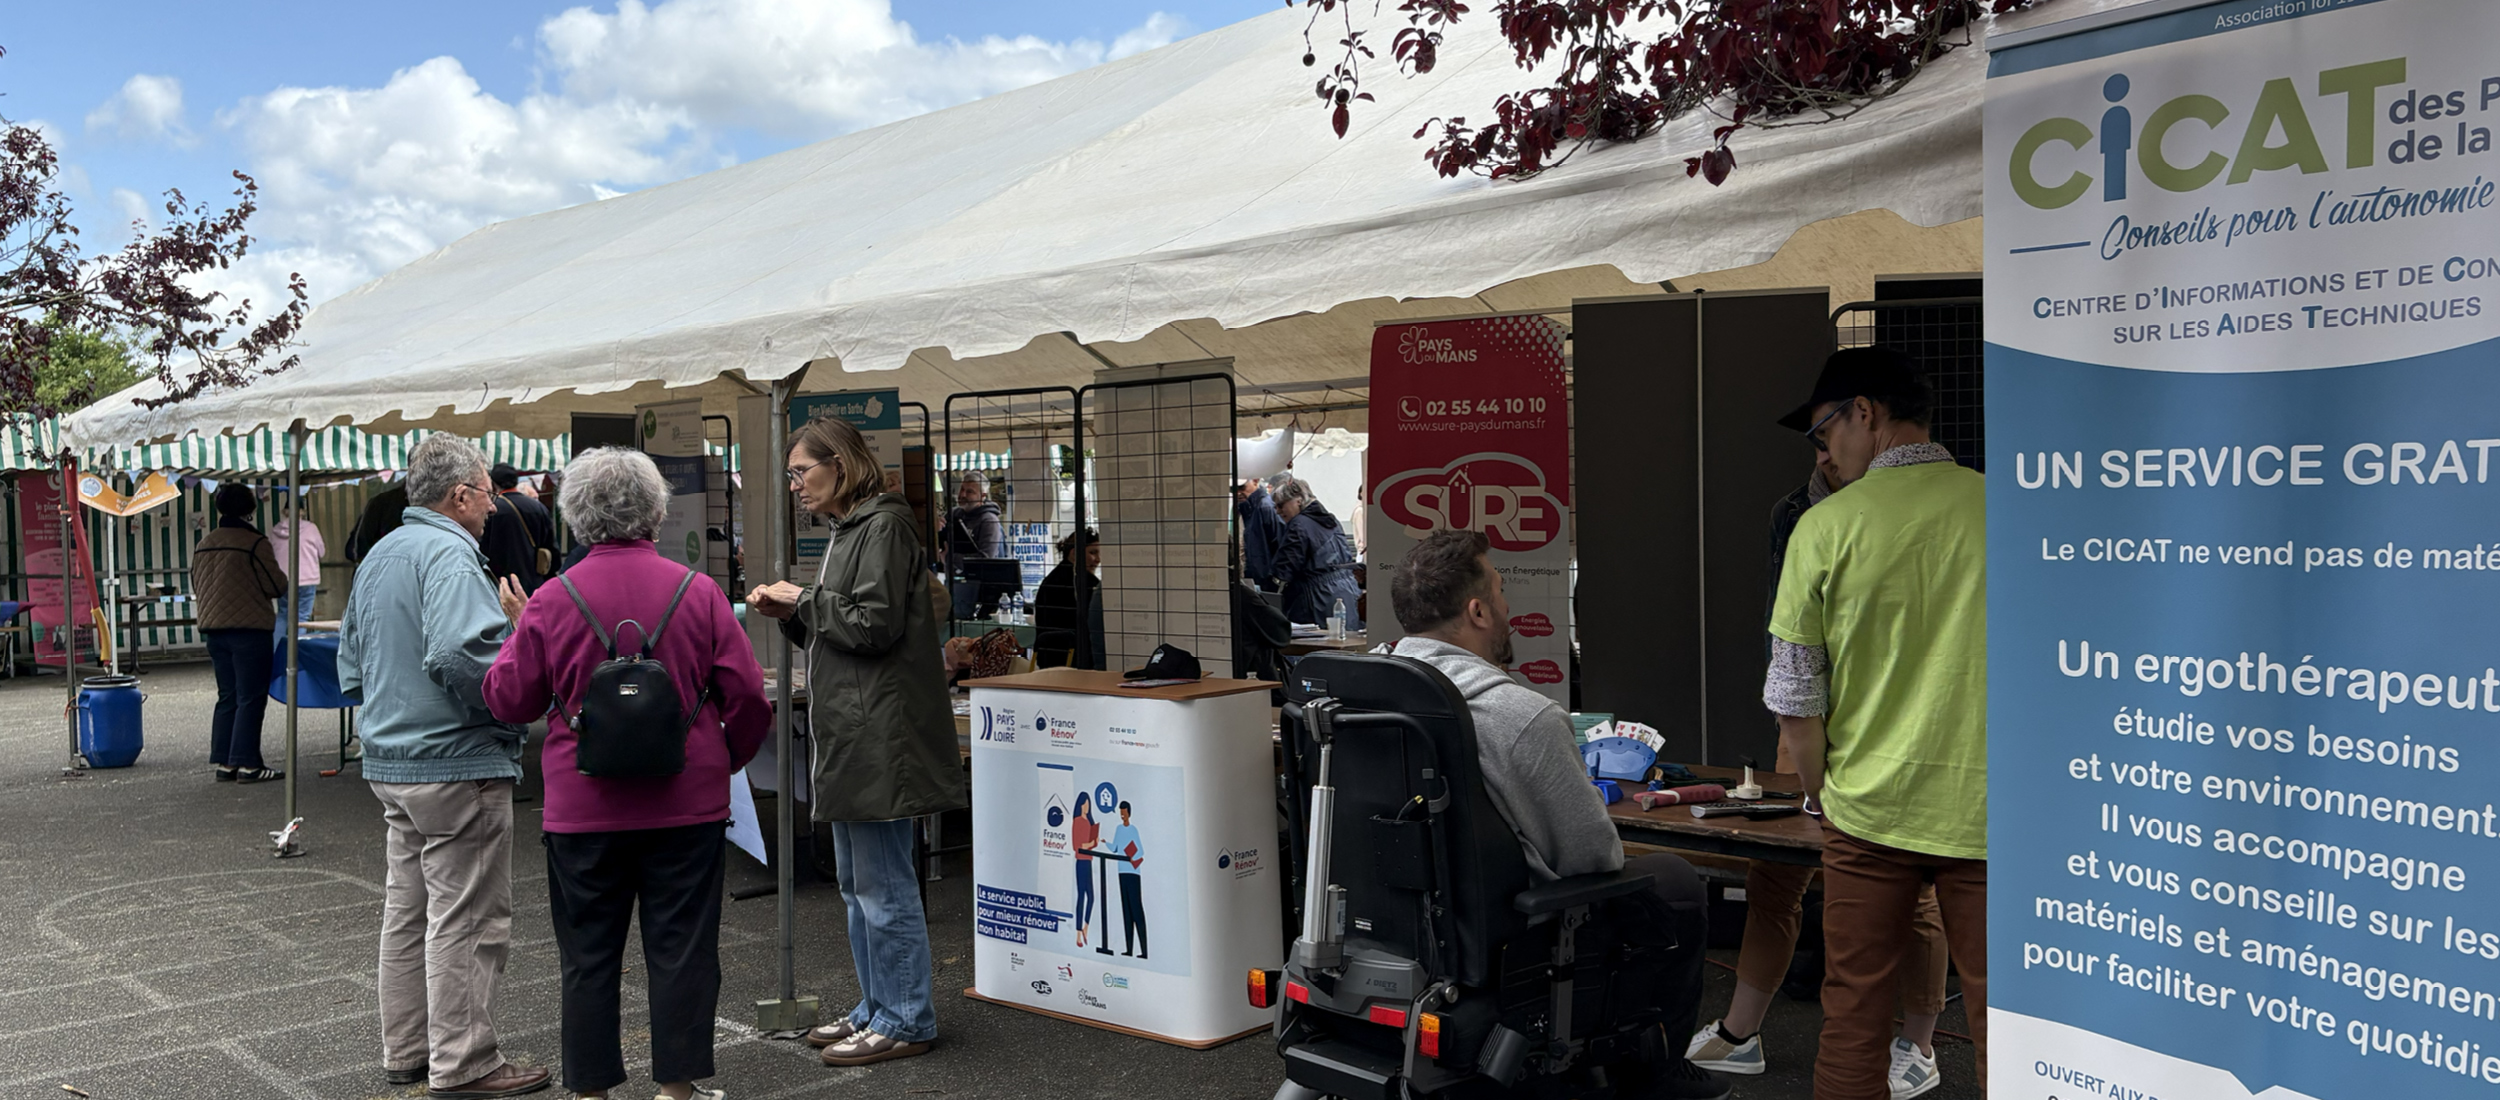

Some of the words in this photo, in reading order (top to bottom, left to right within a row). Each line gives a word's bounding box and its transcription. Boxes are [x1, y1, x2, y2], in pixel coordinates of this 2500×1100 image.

[2214, 1, 2306, 30] Association
[2389, 89, 2465, 124] des
[2388, 129, 2442, 164] de
[2457, 122, 2491, 156] la
[2101, 206, 2227, 260] Conseils
[2225, 207, 2299, 247] pour
[2309, 175, 2496, 229] l'autonomie
[2033, 295, 2127, 319] CENTRE
[2354, 269, 2389, 291] ET
[2398, 264, 2434, 288] DE
[2113, 325, 2162, 344] SUR
[2170, 319, 2209, 341] LES
[2216, 312, 2293, 336] AIDES
[2301, 296, 2482, 329] TECHNIQUES
[1418, 338, 1452, 352] PAYS
[1436, 349, 1477, 363] MANS
[1426, 400, 1447, 416] 02
[1450, 400, 1471, 415] 55
[1476, 399, 1500, 414] 44
[1505, 397, 1524, 414] 10
[1528, 396, 1546, 413] 10
[1398, 417, 1546, 433] www.sure-paysdumans.fr
[2015, 450, 2083, 489] UN
[2100, 444, 2325, 489] SERVICE
[2343, 439, 2500, 486] GRAT
[1403, 482, 1547, 542] SURE
[1513, 565, 1560, 576] Énergétique
[2042, 537, 2075, 561] Le
[2083, 538, 2172, 563] CICAT
[2179, 545, 2210, 564] ne
[2217, 540, 2294, 566] vend
[2305, 545, 2364, 573] pas
[2373, 542, 2413, 569] de
[2058, 639, 2120, 680] Un
[2134, 652, 2500, 714] ergothérapeut
[994, 731, 1015, 743] LOIRE
[996, 714, 1015, 726] PAYS
[1051, 717, 1077, 729] France
[2113, 708, 2215, 745] étudie
[2226, 724, 2294, 754] vos
[2308, 724, 2461, 773] besoins
[2068, 753, 2102, 782] et
[2111, 760, 2192, 793] votre
[1043, 829, 1066, 840] France
[2101, 803, 2119, 833] Il
[2129, 814, 2202, 848] vous
[2213, 828, 2466, 892] accompagne
[1234, 849, 1258, 861] France
[978, 887, 986, 899] Le
[987, 891, 1016, 905] service
[1017, 896, 1044, 910] public
[2067, 850, 2100, 879] et
[2108, 859, 2180, 895] vous
[2190, 877, 2358, 929] conseille
[2368, 909, 2433, 945] sur
[2444, 916, 2500, 960] les
[978, 906, 994, 919] pour
[996, 909, 1022, 924] mieux
[1023, 914, 1057, 930] rénover
[978, 924, 994, 936] mon
[995, 925, 1026, 942] habitat
[2035, 896, 2183, 948] matériels
[2193, 927, 2232, 958] et
[2241, 939, 2500, 1022] aménagemen
[2023, 941, 2100, 977] pour
[2107, 954, 2237, 1009] faciliter
[2246, 990, 2337, 1037] votre
[2347, 1019, 2500, 1084] quotidie
[2034, 1061, 2105, 1094] OUVERT
